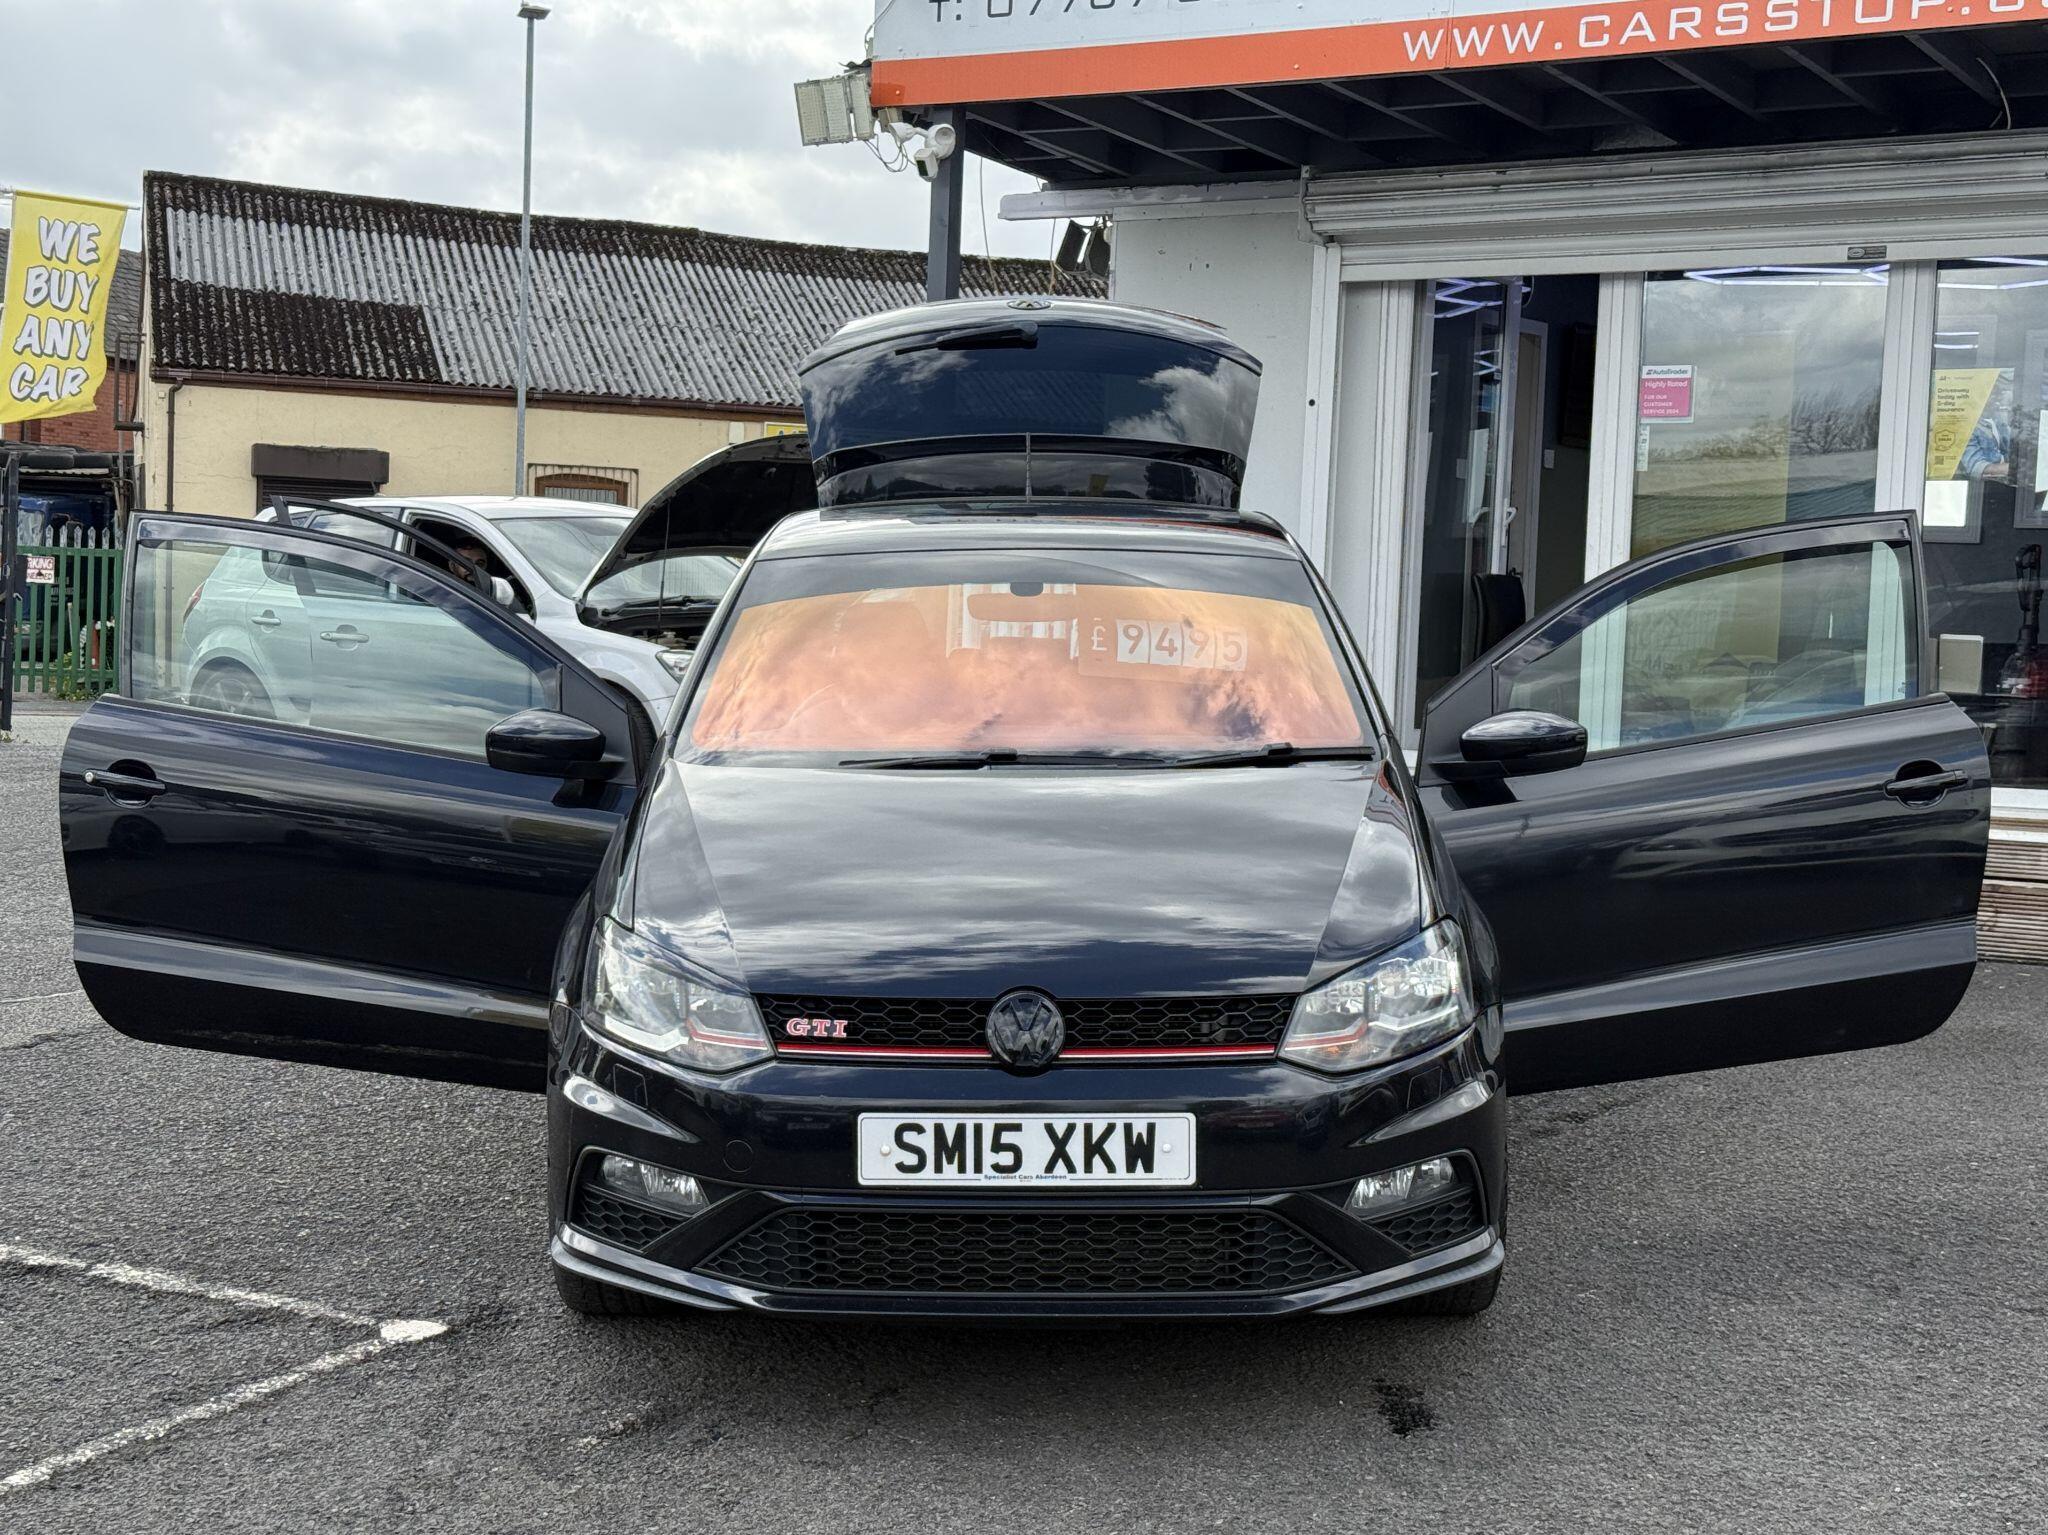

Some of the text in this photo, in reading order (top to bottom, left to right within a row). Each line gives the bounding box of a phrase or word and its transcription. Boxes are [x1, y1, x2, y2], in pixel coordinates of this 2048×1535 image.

[1403, 0, 2048, 61] WWW.CARSSTOP.
[38, 216, 101, 265] WE
[24, 265, 100, 314] BUY
[13, 314, 94, 361] ANY
[9, 362, 90, 402] CAR
[1645, 380, 1688, 389] Highly Rated
[786, 1017, 848, 1038] GTI
[894, 1122, 1156, 1174] SM15 XKW
